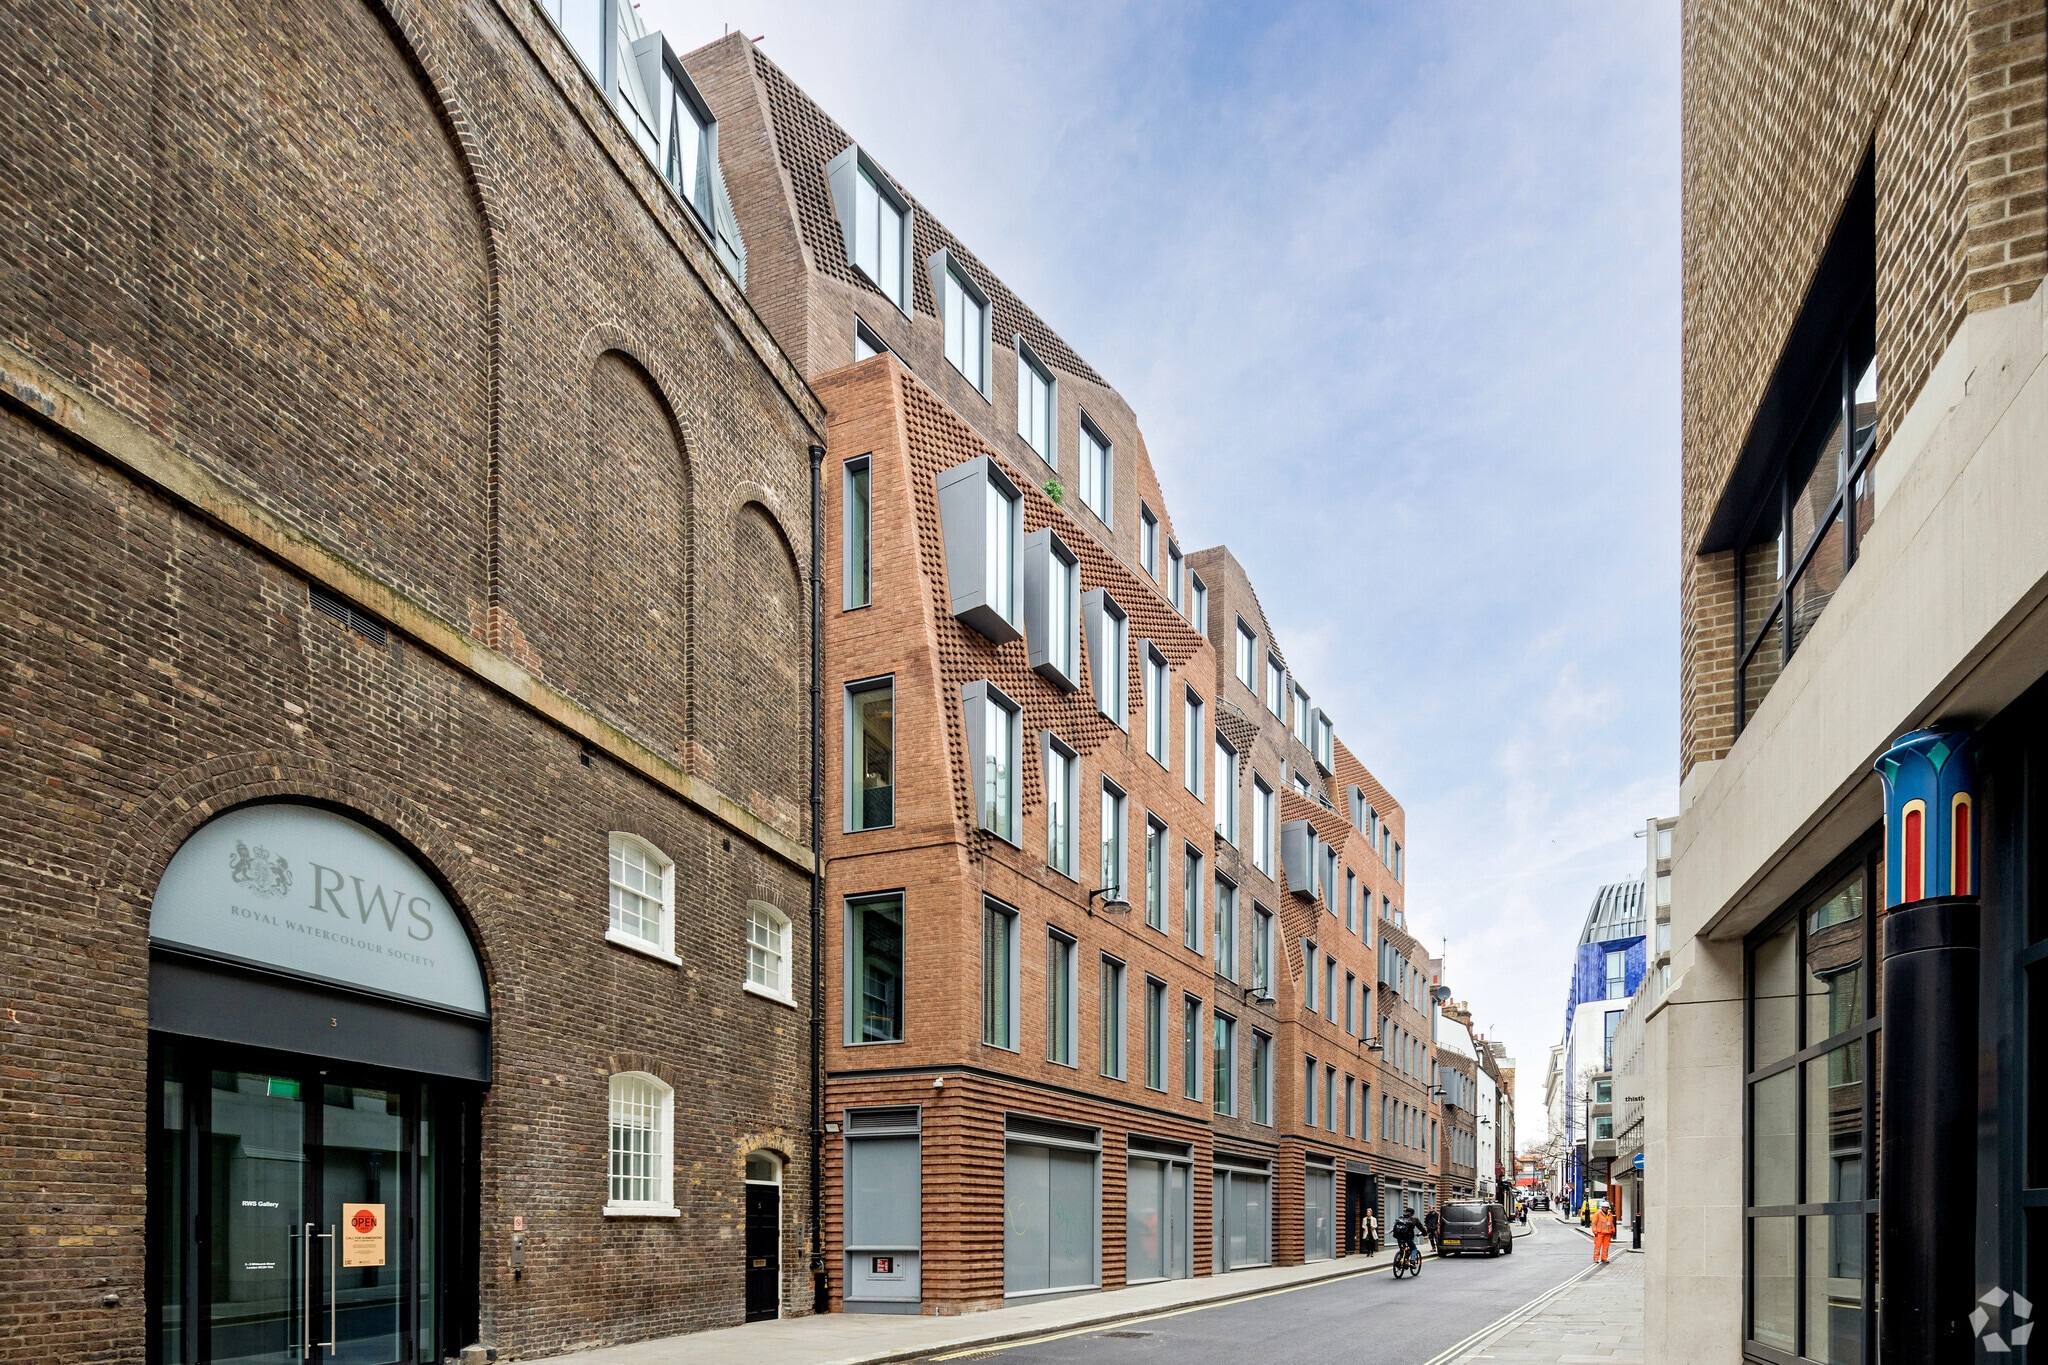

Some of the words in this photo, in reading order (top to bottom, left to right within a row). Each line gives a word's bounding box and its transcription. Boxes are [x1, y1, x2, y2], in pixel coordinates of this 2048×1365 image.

[309, 861, 434, 941] RWS
[231, 905, 279, 926] ROYAL
[285, 920, 383, 954] WATERCOLOUR
[387, 948, 436, 968] SOCIETY
[331, 1017, 337, 1027] 3
[351, 1217, 377, 1227] OPEN
